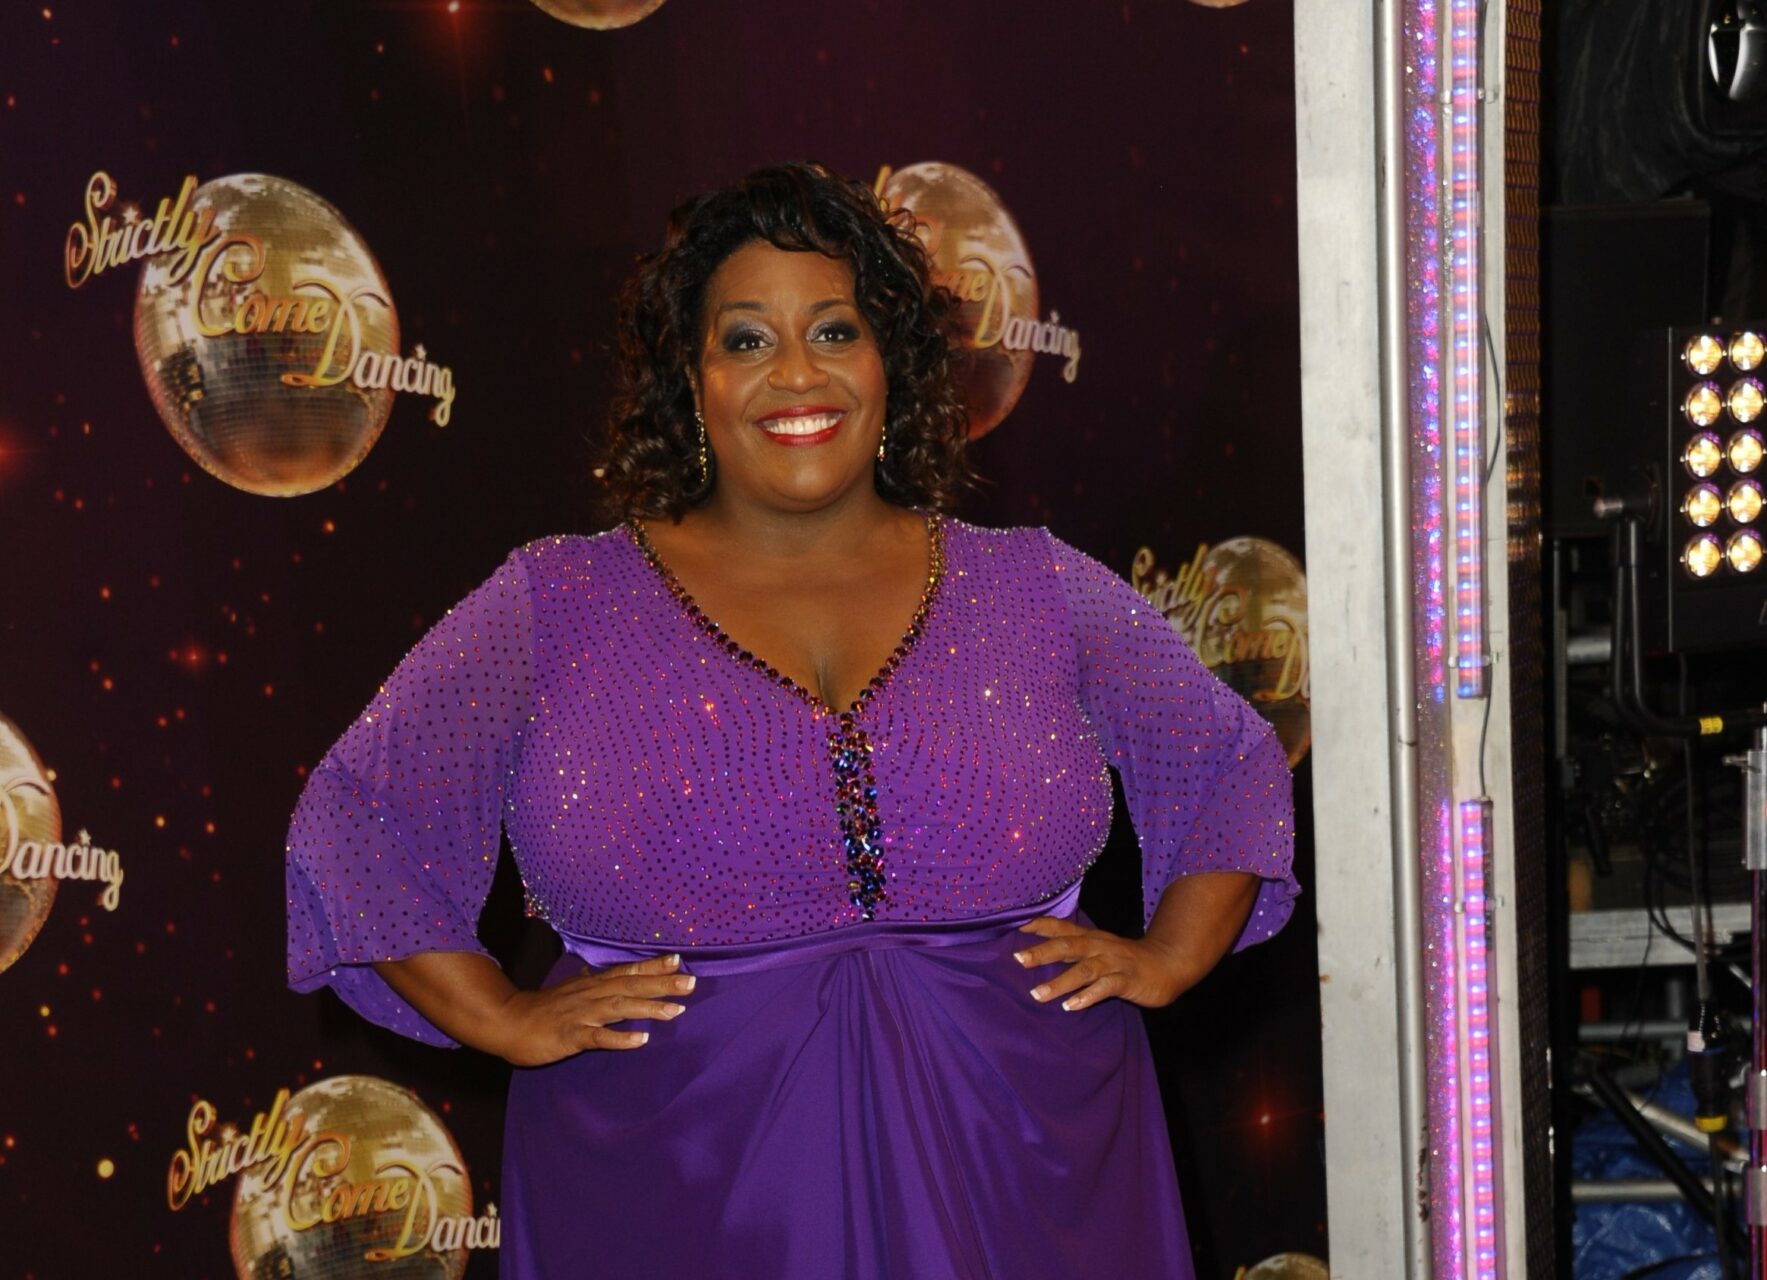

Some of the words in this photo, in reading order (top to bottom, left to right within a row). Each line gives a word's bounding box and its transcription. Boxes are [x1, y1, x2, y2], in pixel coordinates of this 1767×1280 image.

[65, 172, 218, 288] Strictly
[191, 234, 329, 337] Come
[281, 278, 456, 427] Dancing
[959, 254, 1081, 384] Dancing
[1195, 584, 1290, 668] Come
[167, 1088, 308, 1211] Strictly
[283, 1132, 410, 1231] Come
[365, 1159, 500, 1262] Danci
